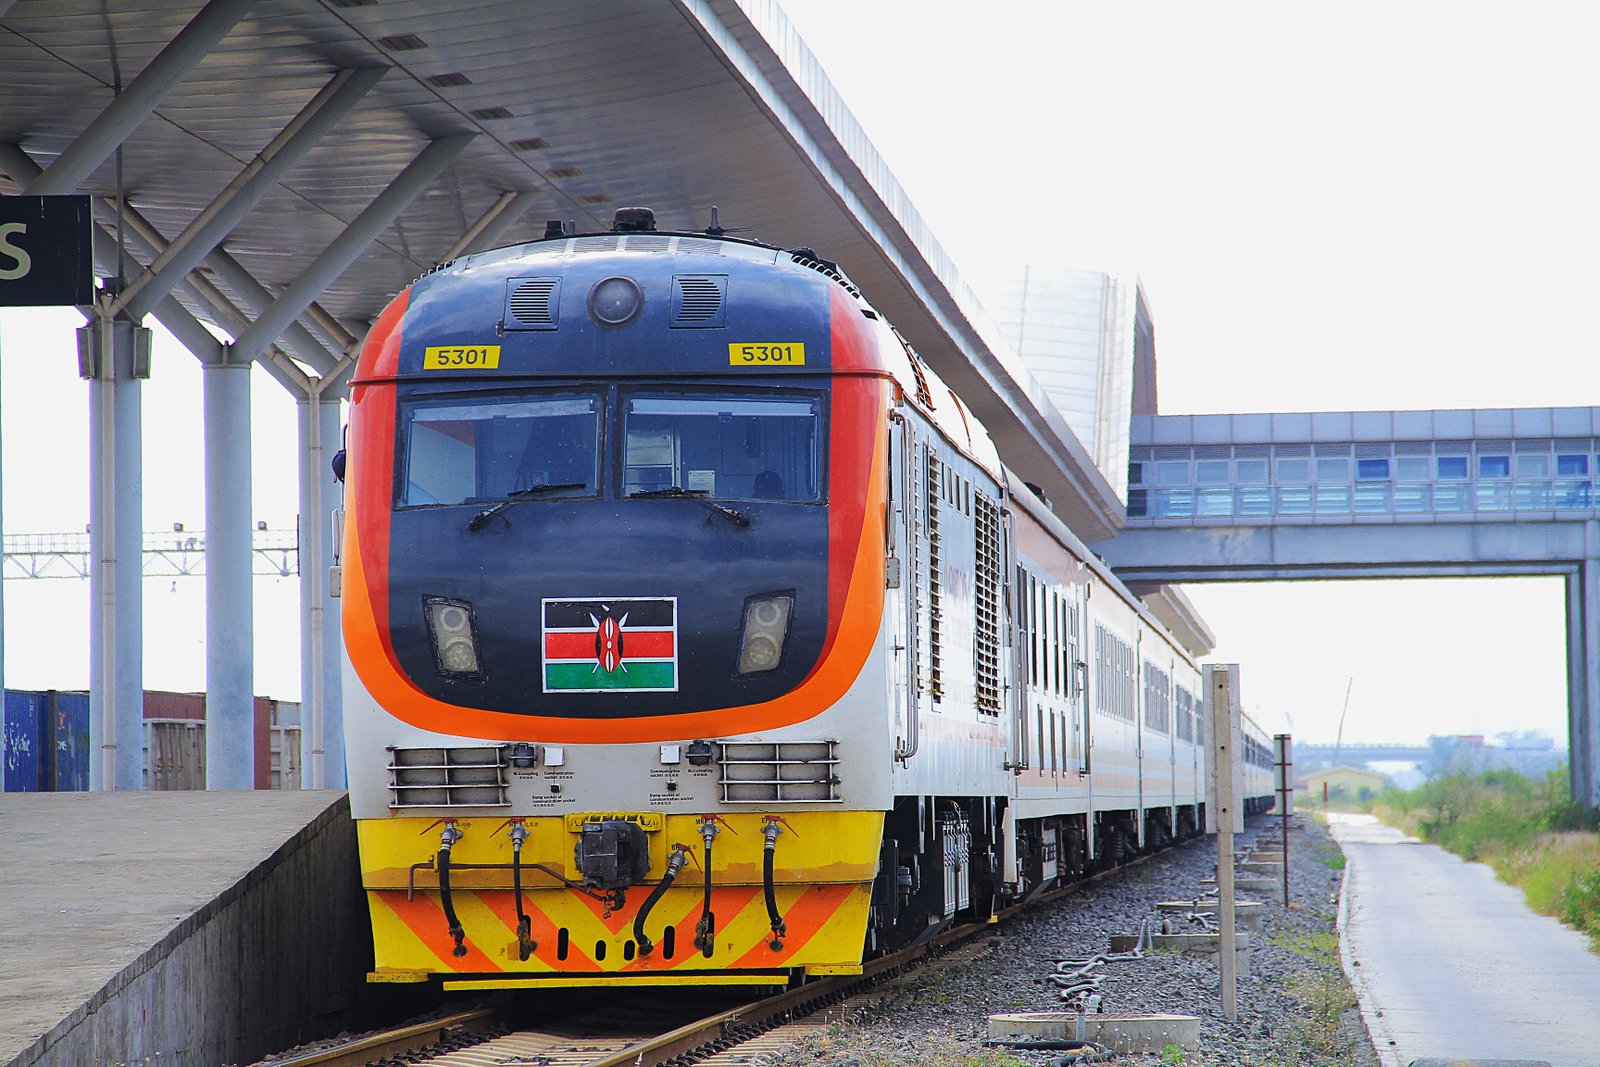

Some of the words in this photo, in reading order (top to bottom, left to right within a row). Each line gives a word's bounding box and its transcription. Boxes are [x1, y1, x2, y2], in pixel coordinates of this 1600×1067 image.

[0, 222, 31, 280] S
[437, 349, 487, 365] 5301
[742, 346, 792, 362] 5301
